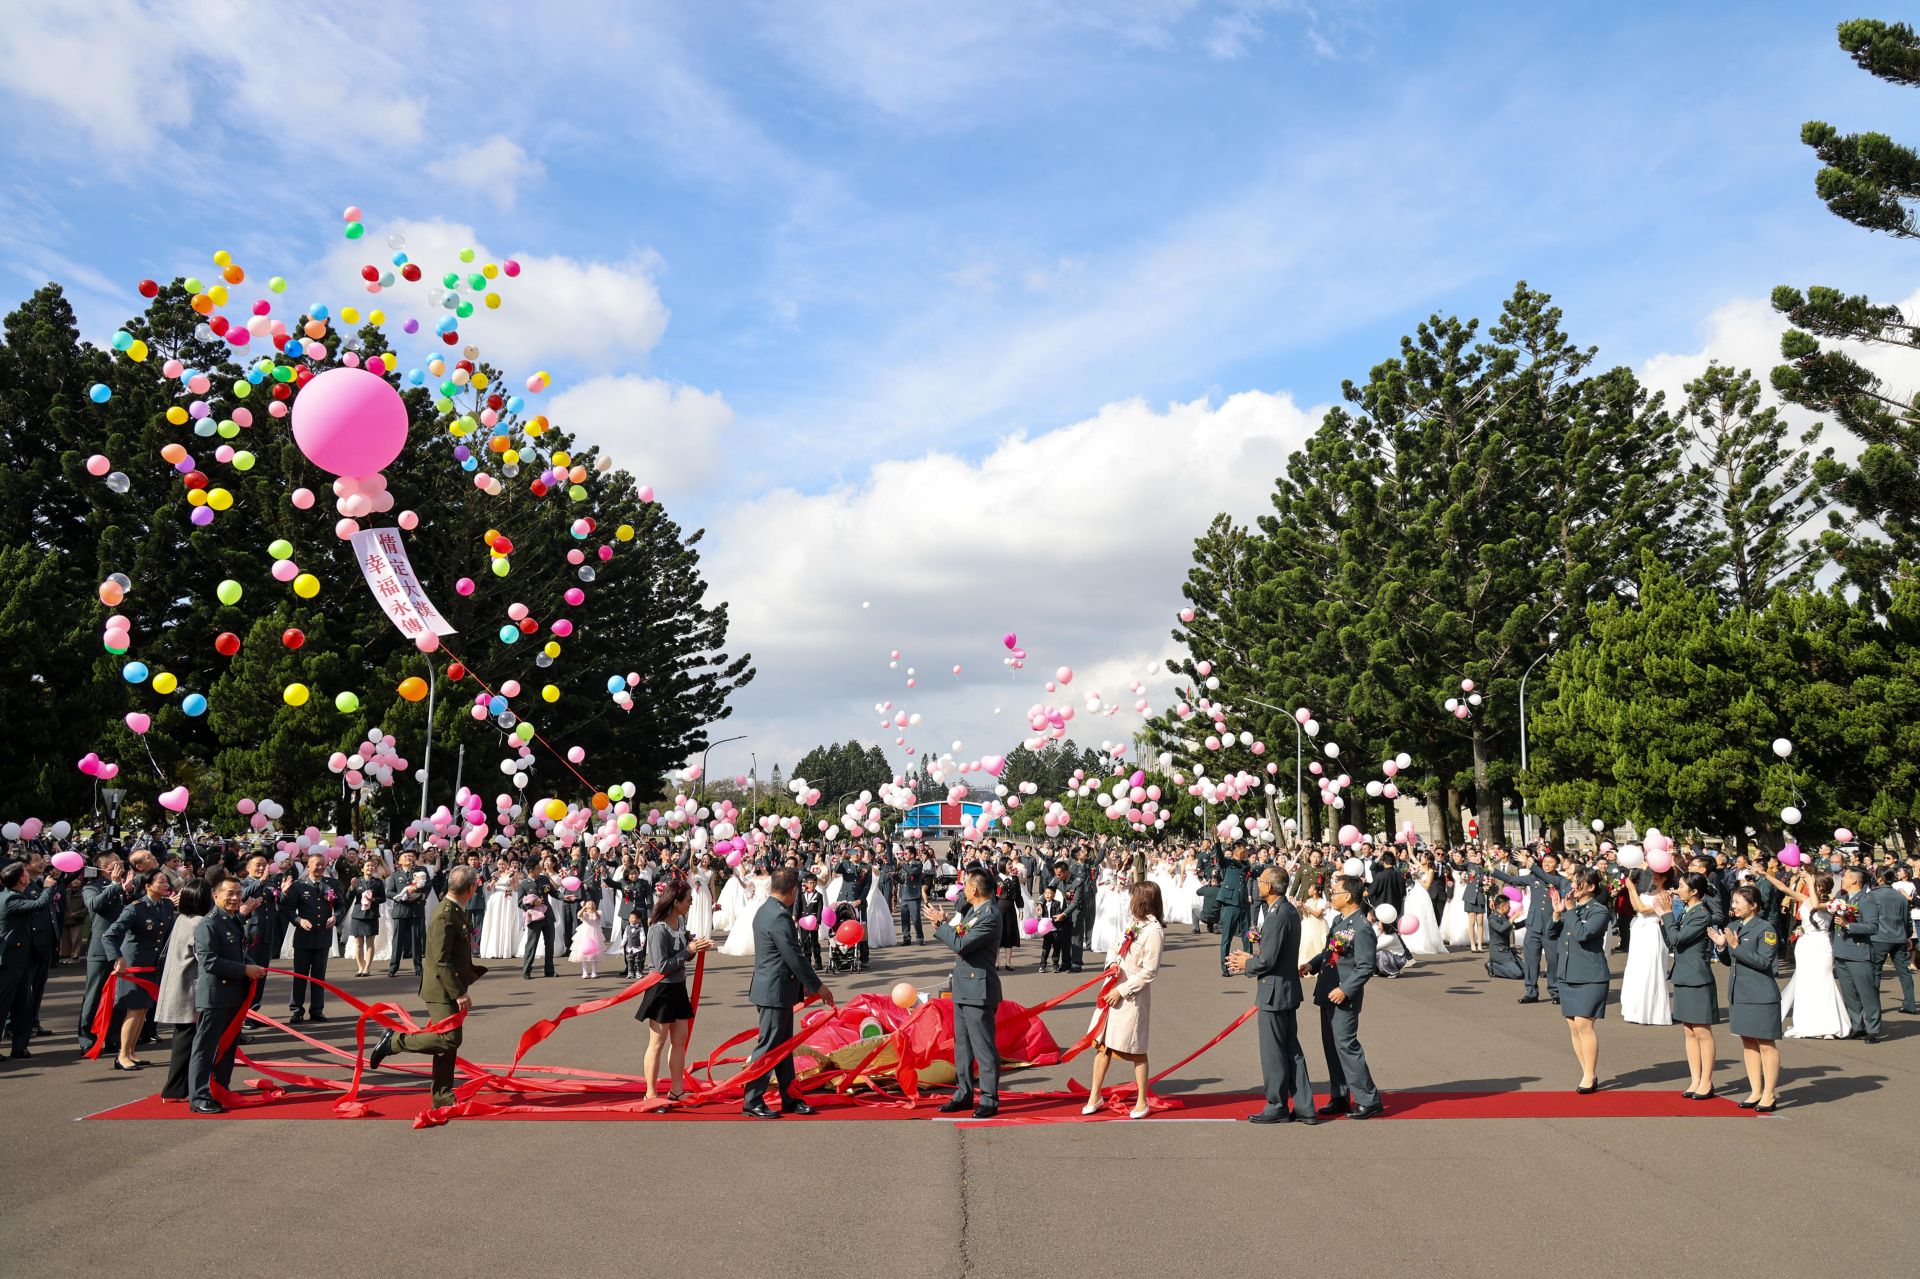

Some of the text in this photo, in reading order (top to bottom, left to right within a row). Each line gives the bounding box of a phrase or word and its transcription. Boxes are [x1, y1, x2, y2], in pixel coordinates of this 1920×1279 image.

[364, 554, 424, 633] 幸福永傳
[379, 533, 436, 617] 情定大漢
